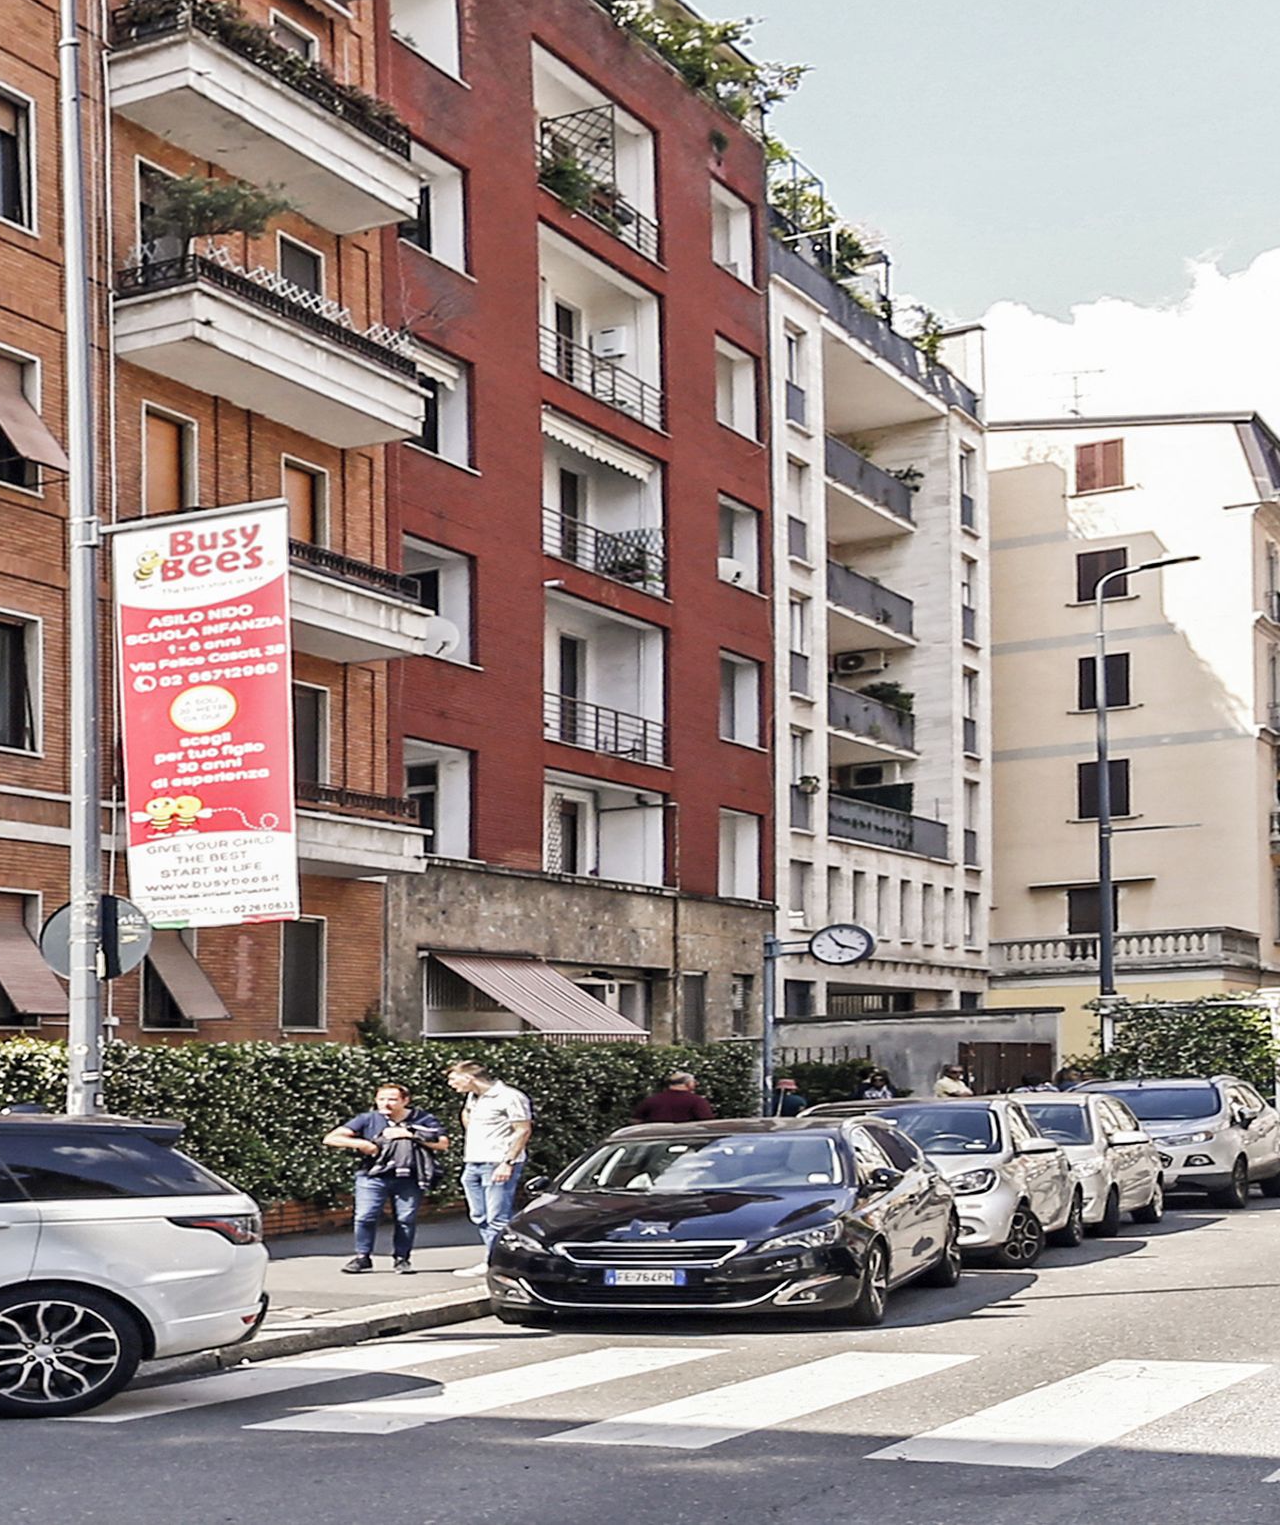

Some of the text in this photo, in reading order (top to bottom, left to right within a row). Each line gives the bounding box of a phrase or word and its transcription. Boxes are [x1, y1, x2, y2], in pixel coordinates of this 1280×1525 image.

[170, 524, 260, 557] Busy
[161, 545, 263, 582] Bees
[148, 604, 253, 629] ASILO NIDO
[125, 616, 283, 646] SCUOLA INFANZIA
[168, 644, 177, 655] 1
[203, 636, 242, 650] anni
[129, 661, 156, 673] Via
[158, 654, 205, 670] Felice
[179, 731, 232, 748] scegli
[154, 742, 265, 765] per tuo figlio
[201, 757, 242, 771] anni
[151, 768, 270, 789] di esperienza
[146, 835, 275, 855] GIVE YOUR CHILD
[176, 850, 248, 865] THE BEST
[160, 861, 262, 879] START IN LIFE
